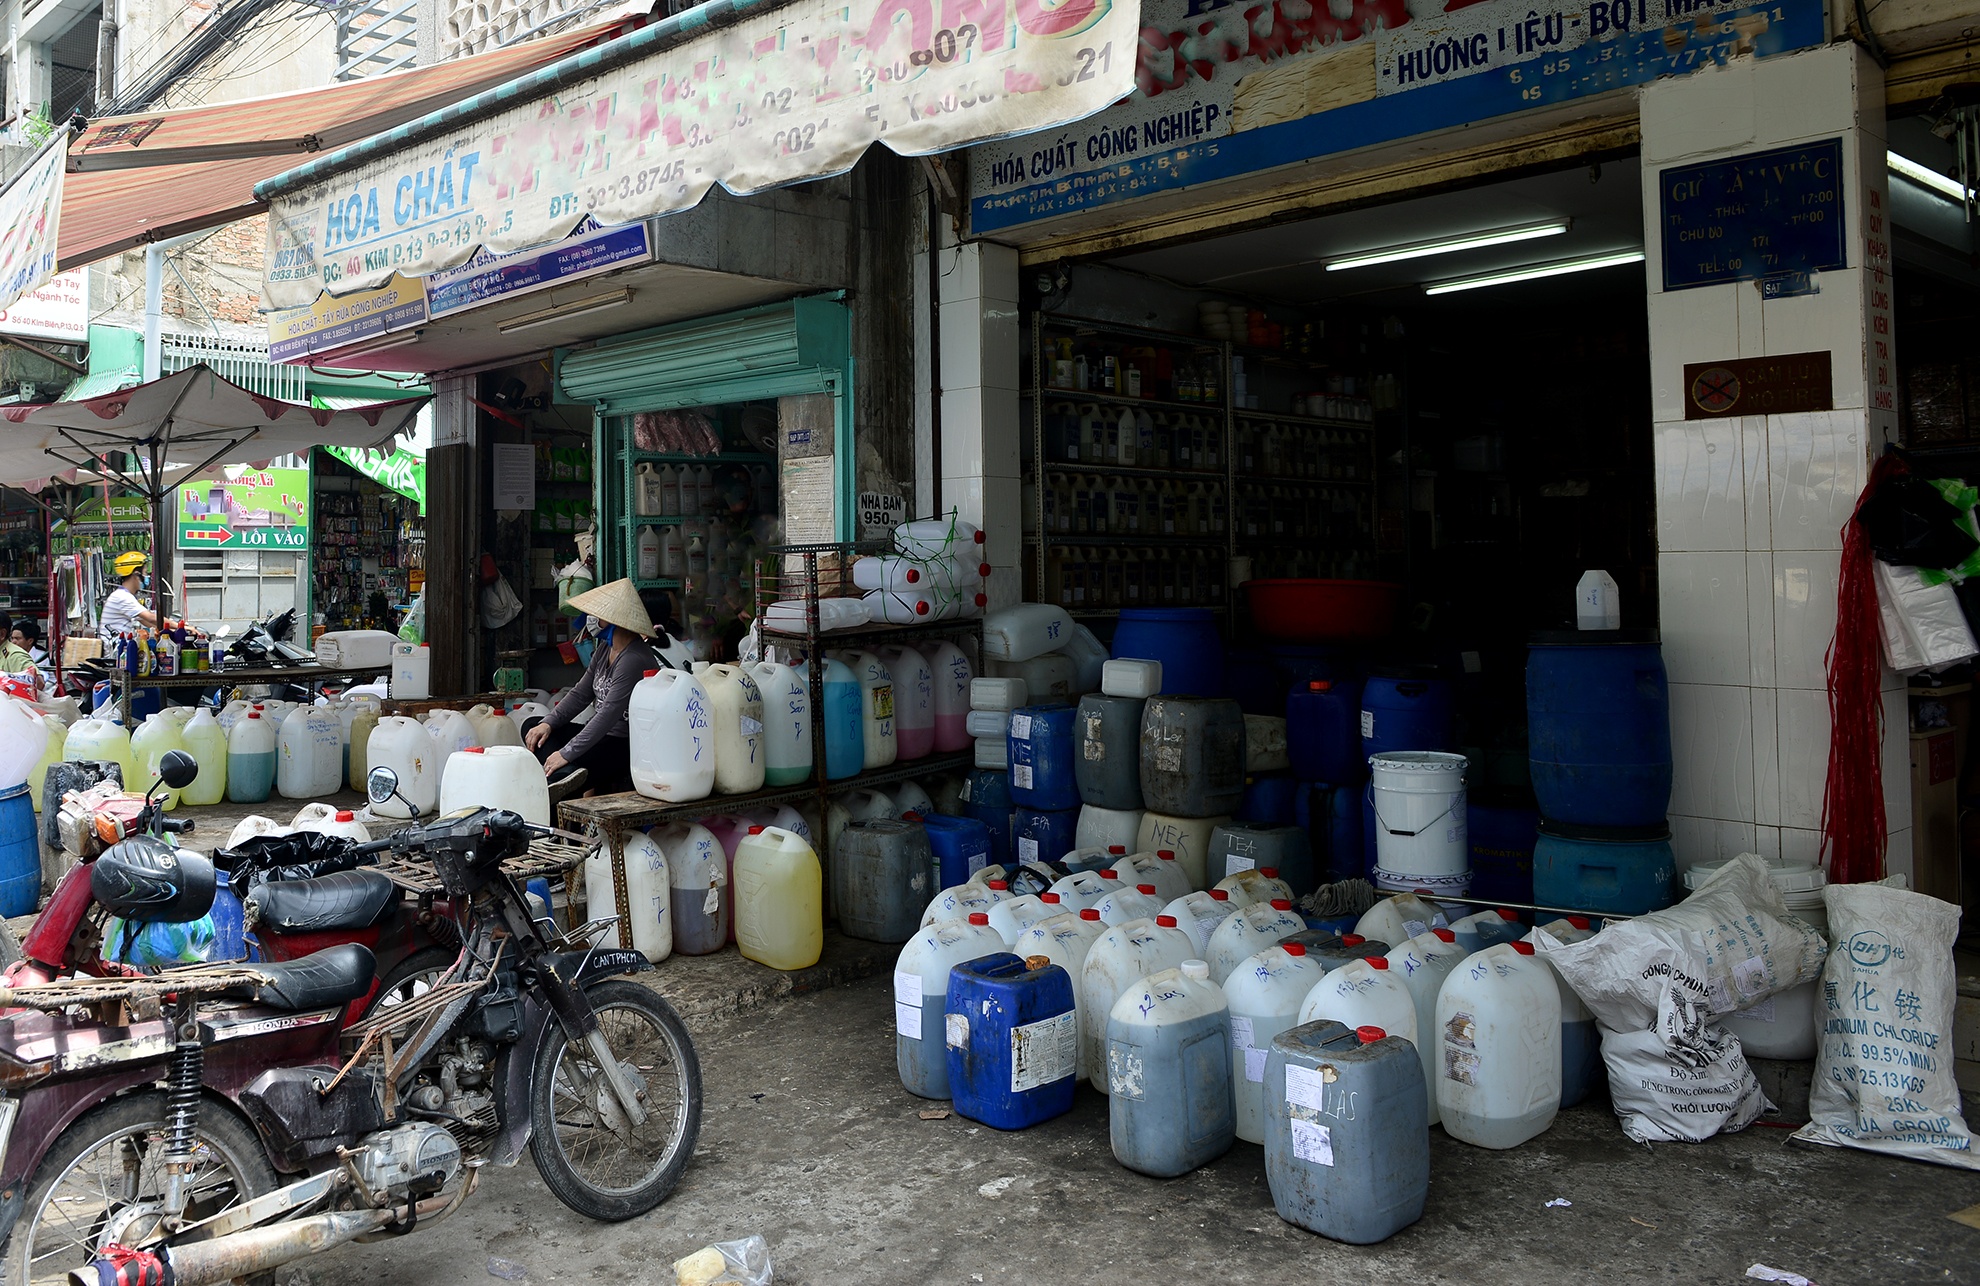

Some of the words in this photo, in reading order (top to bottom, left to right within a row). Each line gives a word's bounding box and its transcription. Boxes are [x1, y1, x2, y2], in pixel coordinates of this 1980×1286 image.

[1399, 32, 1488, 85] HƯƠNG
[1086, 125, 1138, 162] CÔNG
[1144, 100, 1219, 148] NGHIỆP
[325, 183, 380, 248] HÓA
[394, 143, 480, 226] CHẤT
[1870, 190, 1881, 207] XIN
[346, 255, 360, 276] 40
[365, 246, 388, 272] KIM
[64, 279, 80, 290] Tay
[64, 293, 80, 305] Tóc
[1872, 289, 1888, 311] LÒNG
[288, 321, 301, 335] HÓA
[302, 313, 318, 331] CHẤT
[350, 300, 371, 316] CÔNG
[371, 290, 399, 309] NGHIỆP
[1875, 341, 1888, 360] TRA
[1875, 389, 1892, 409] HÀNG
[864, 511, 890, 525] 950
[273, 530, 305, 545] VÀO
[1150, 819, 1190, 855] MEK
[1837, 940, 1848, 951] 大
[1892, 947, 1905, 960] 化
[252, 1017, 299, 1032] HONDA
[1824, 1018, 1868, 1036] AMMONIUM
[1874, 1021, 1939, 1050] CHLORIDE
[1664, 1085, 1692, 1097] TRONG
[1692, 1084, 1713, 1096] CÔNG
[1325, 1085, 1358, 1120] LAS
[1893, 1116, 1951, 1134] GROUP
[420, 1150, 458, 1167] HONDA
